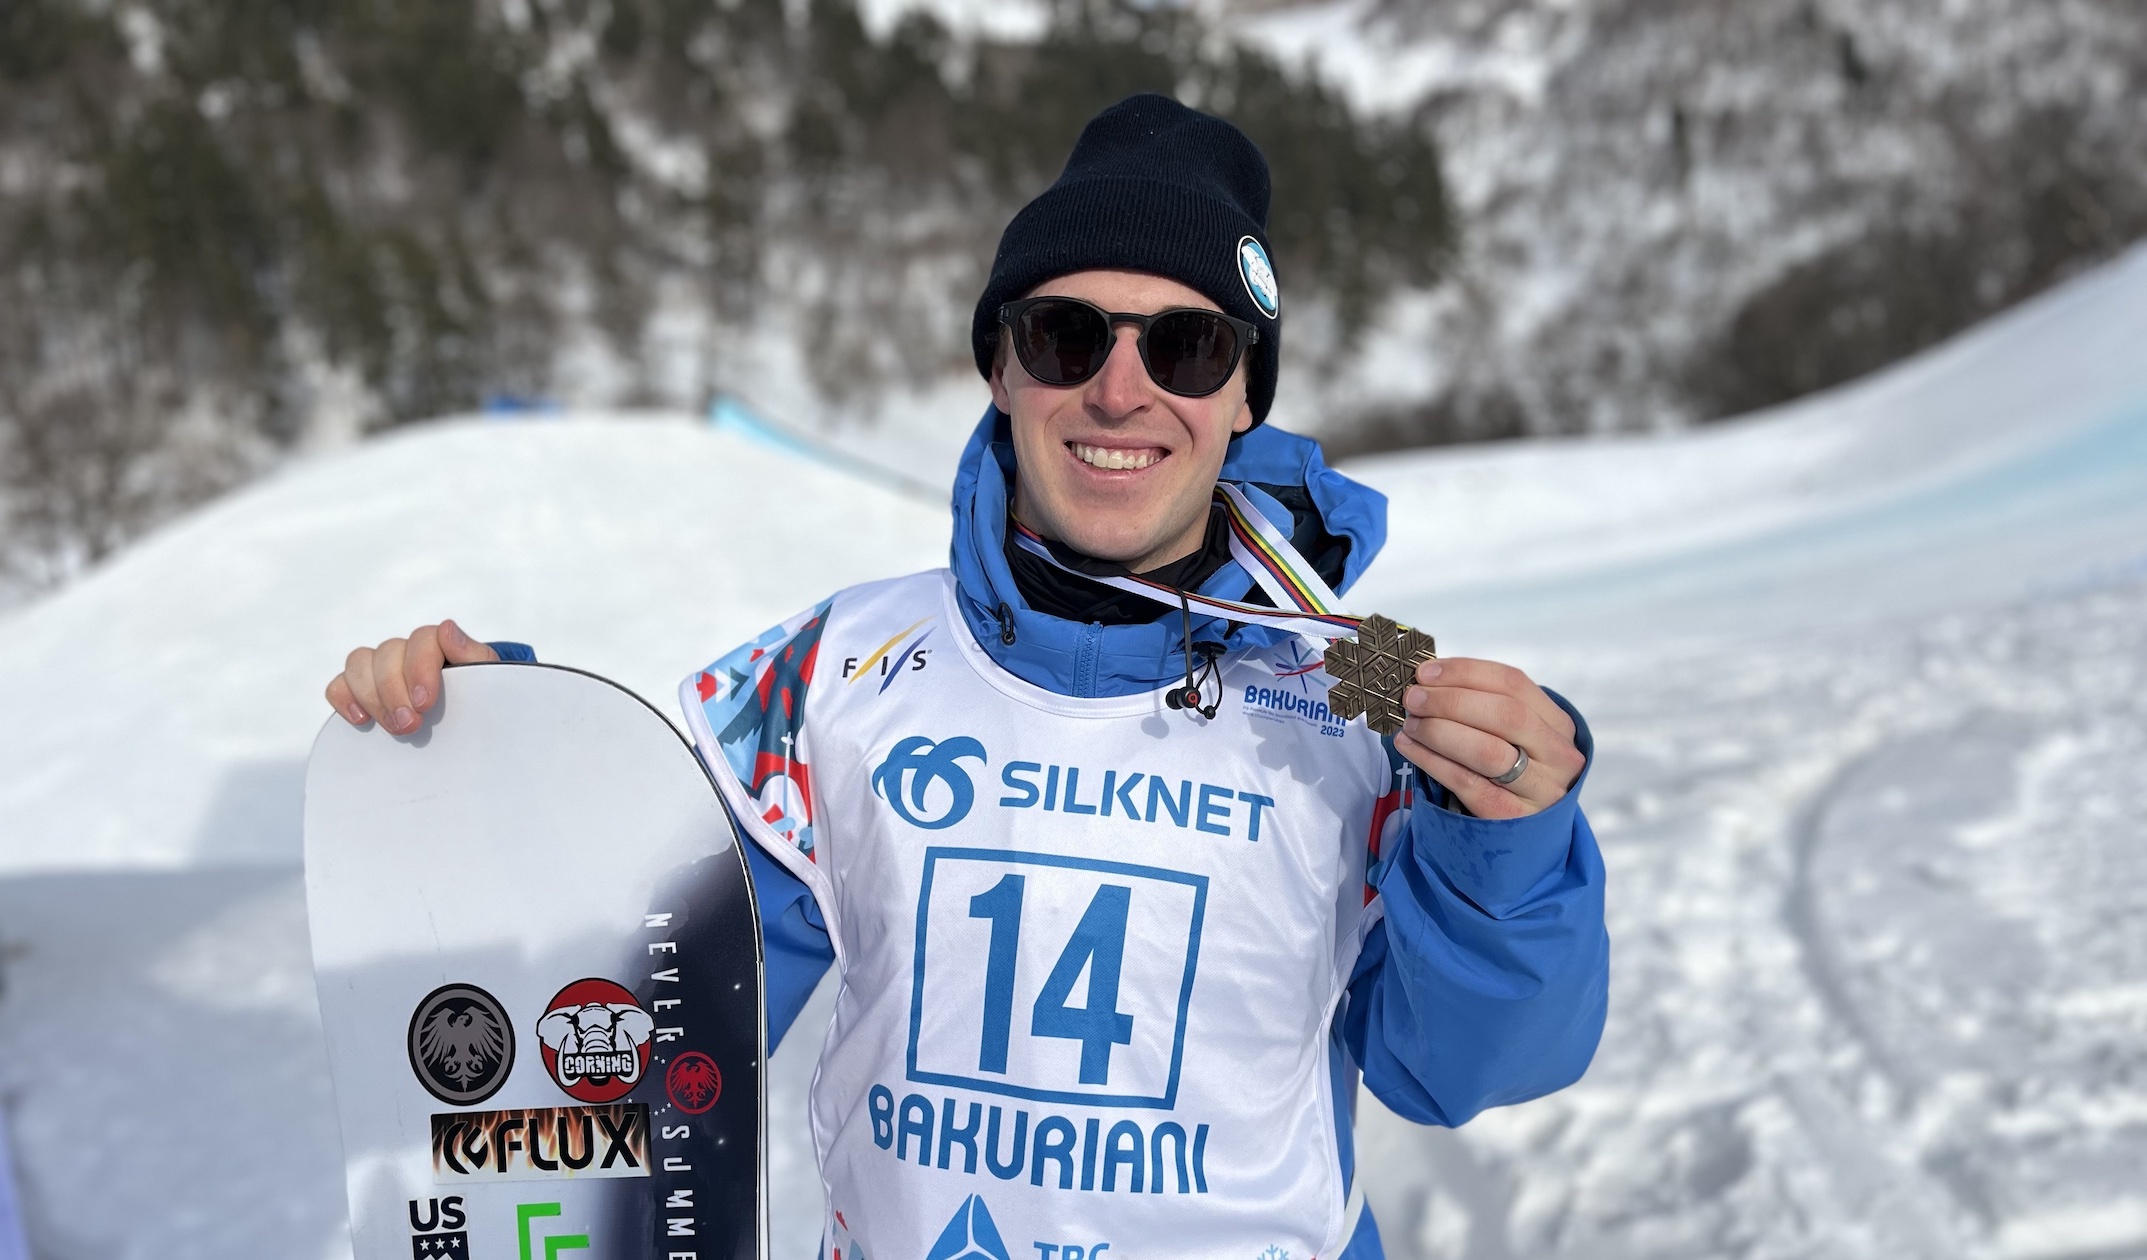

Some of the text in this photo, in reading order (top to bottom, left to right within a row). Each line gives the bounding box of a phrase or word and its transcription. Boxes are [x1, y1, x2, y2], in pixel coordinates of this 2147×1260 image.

[1320, 725, 1345, 738] 2023
[999, 760, 1275, 842] SILKNET
[644, 912, 684, 1043] NEVER
[968, 873, 1134, 1085] 14
[564, 1053, 632, 1074] CORNING
[495, 1111, 640, 1173] FLUX
[868, 1083, 1210, 1194] BAKURIANI
[409, 1196, 466, 1232] US
